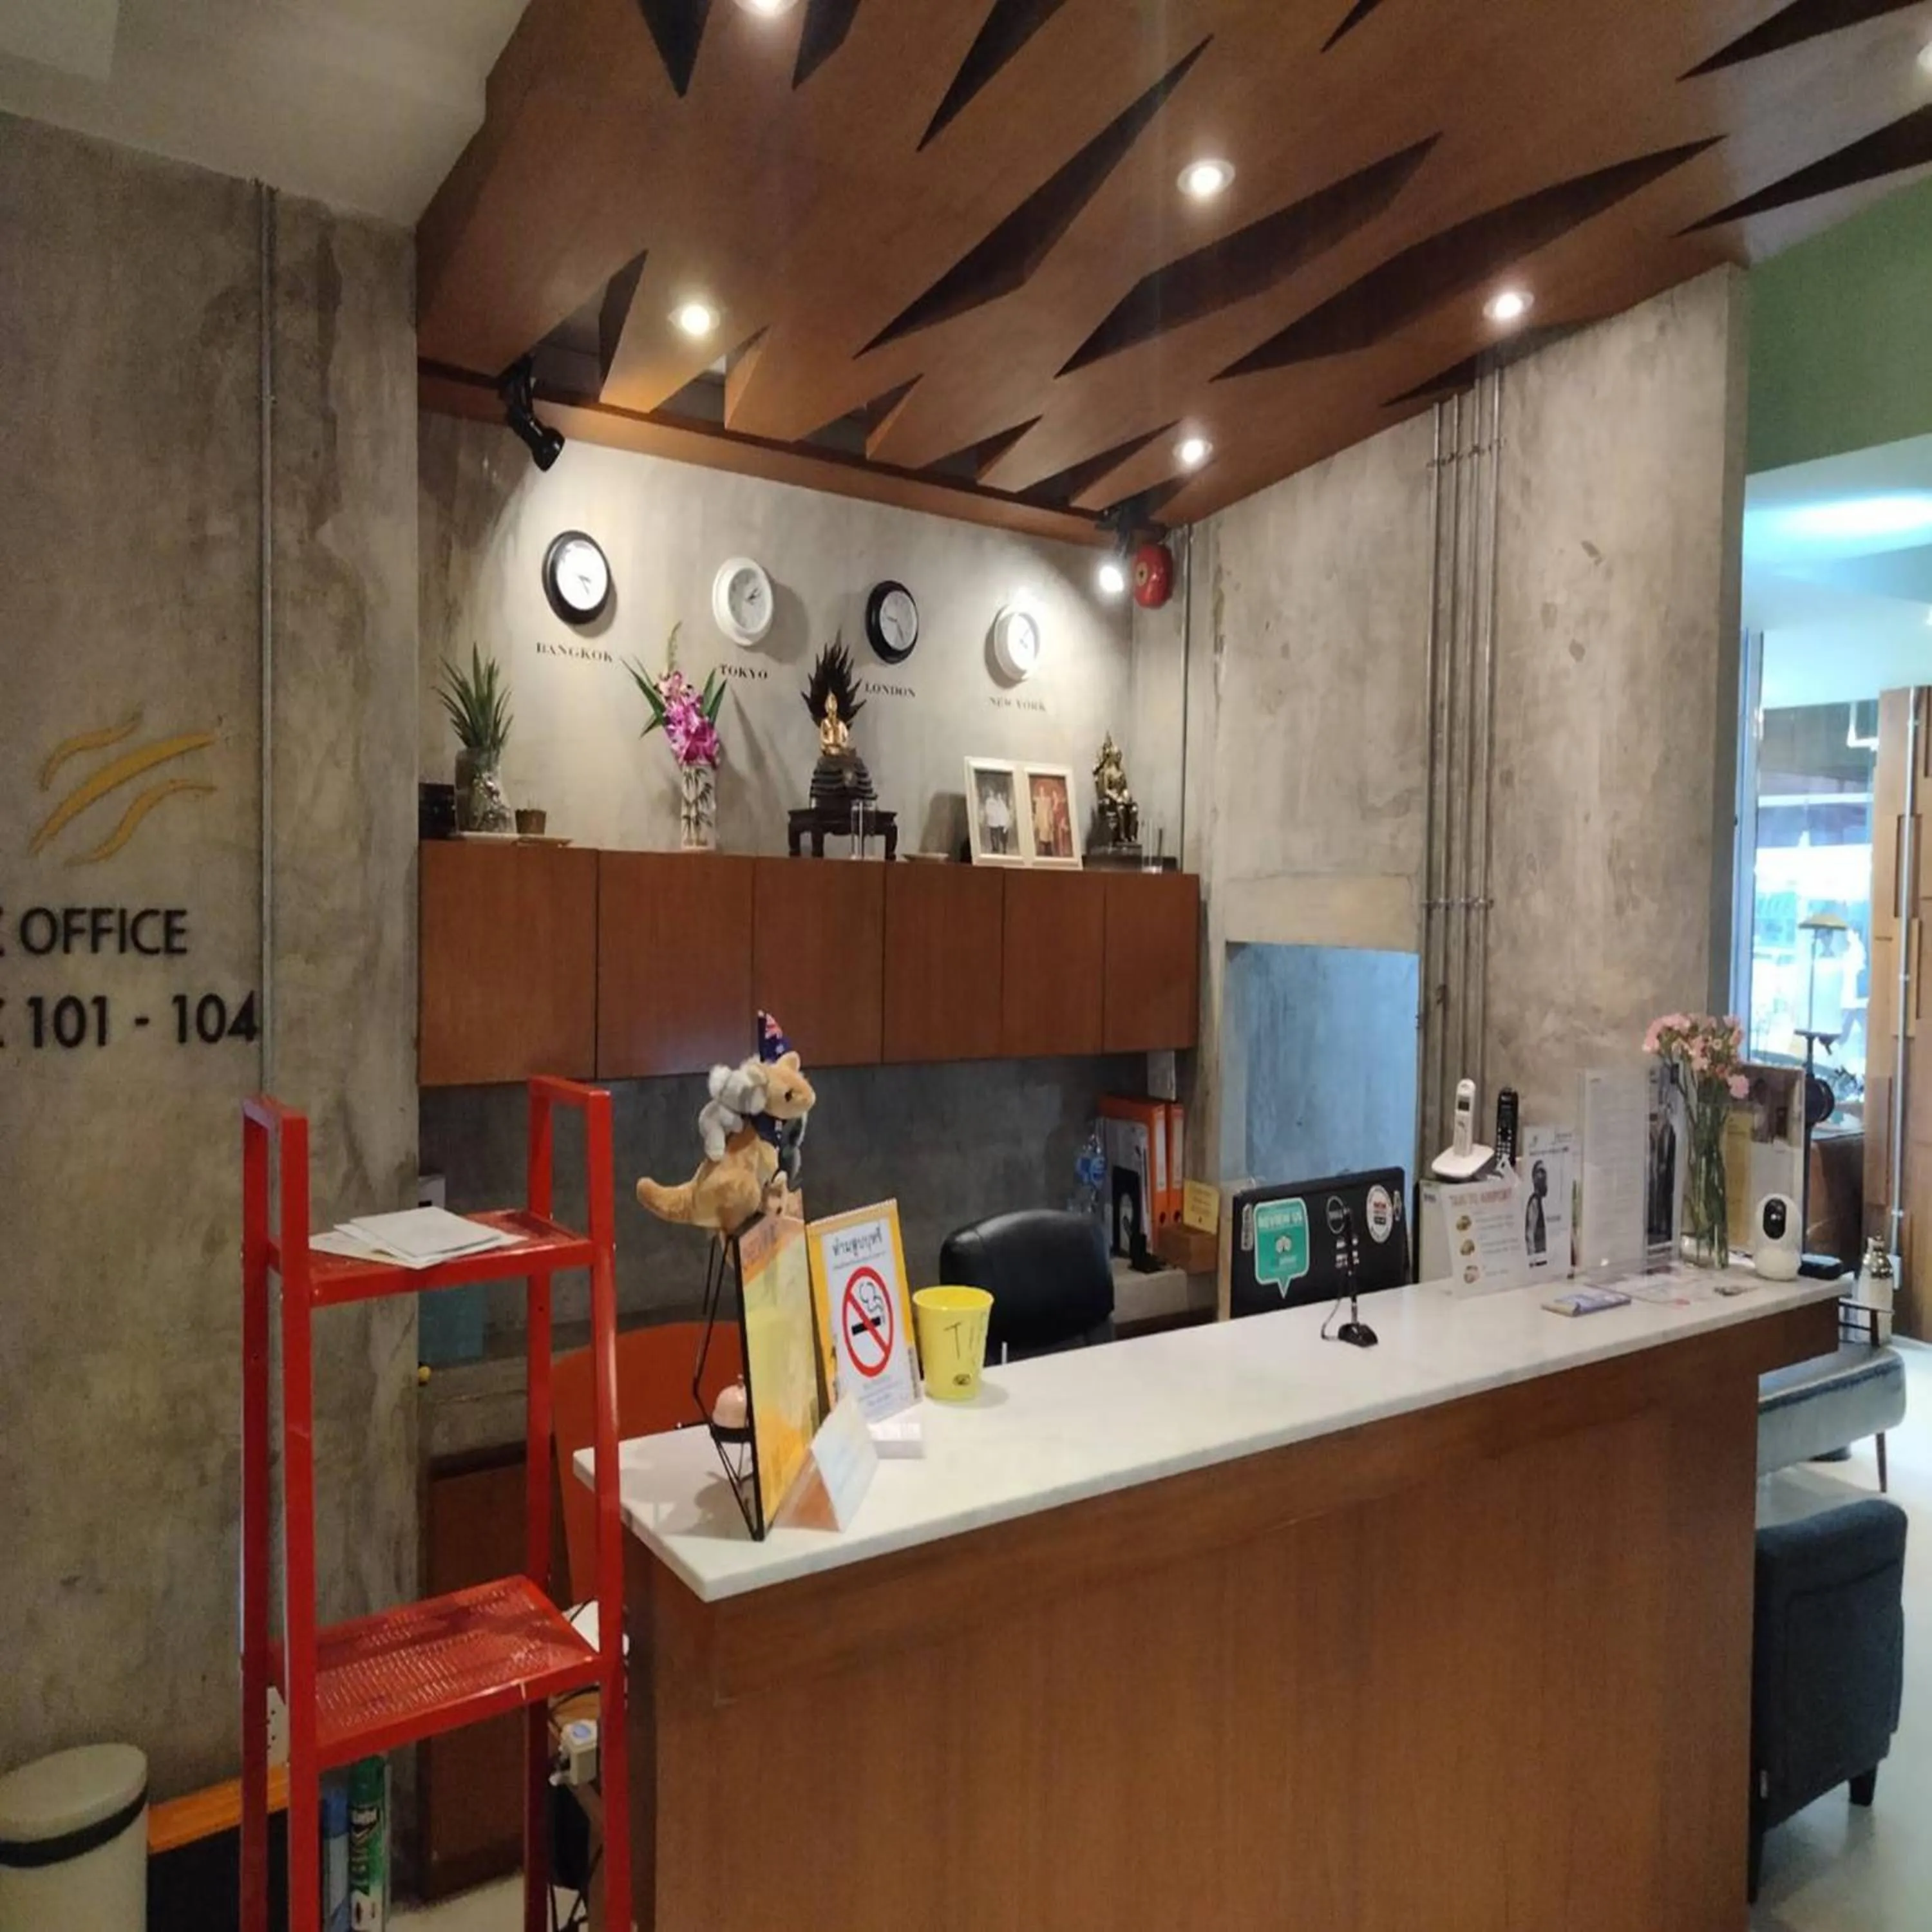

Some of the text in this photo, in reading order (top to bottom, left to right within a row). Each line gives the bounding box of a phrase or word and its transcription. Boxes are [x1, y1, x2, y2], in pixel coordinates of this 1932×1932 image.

[536, 642, 612, 663] BANGKOK
[719, 663, 768, 680] TOKYO
[865, 683, 916, 697] LONDON
[989, 696, 1046, 712] NEW YORK
[19, 907, 188, 954] OFFICE
[27, 995, 108, 1048] 101
[172, 989, 261, 1044] 104
